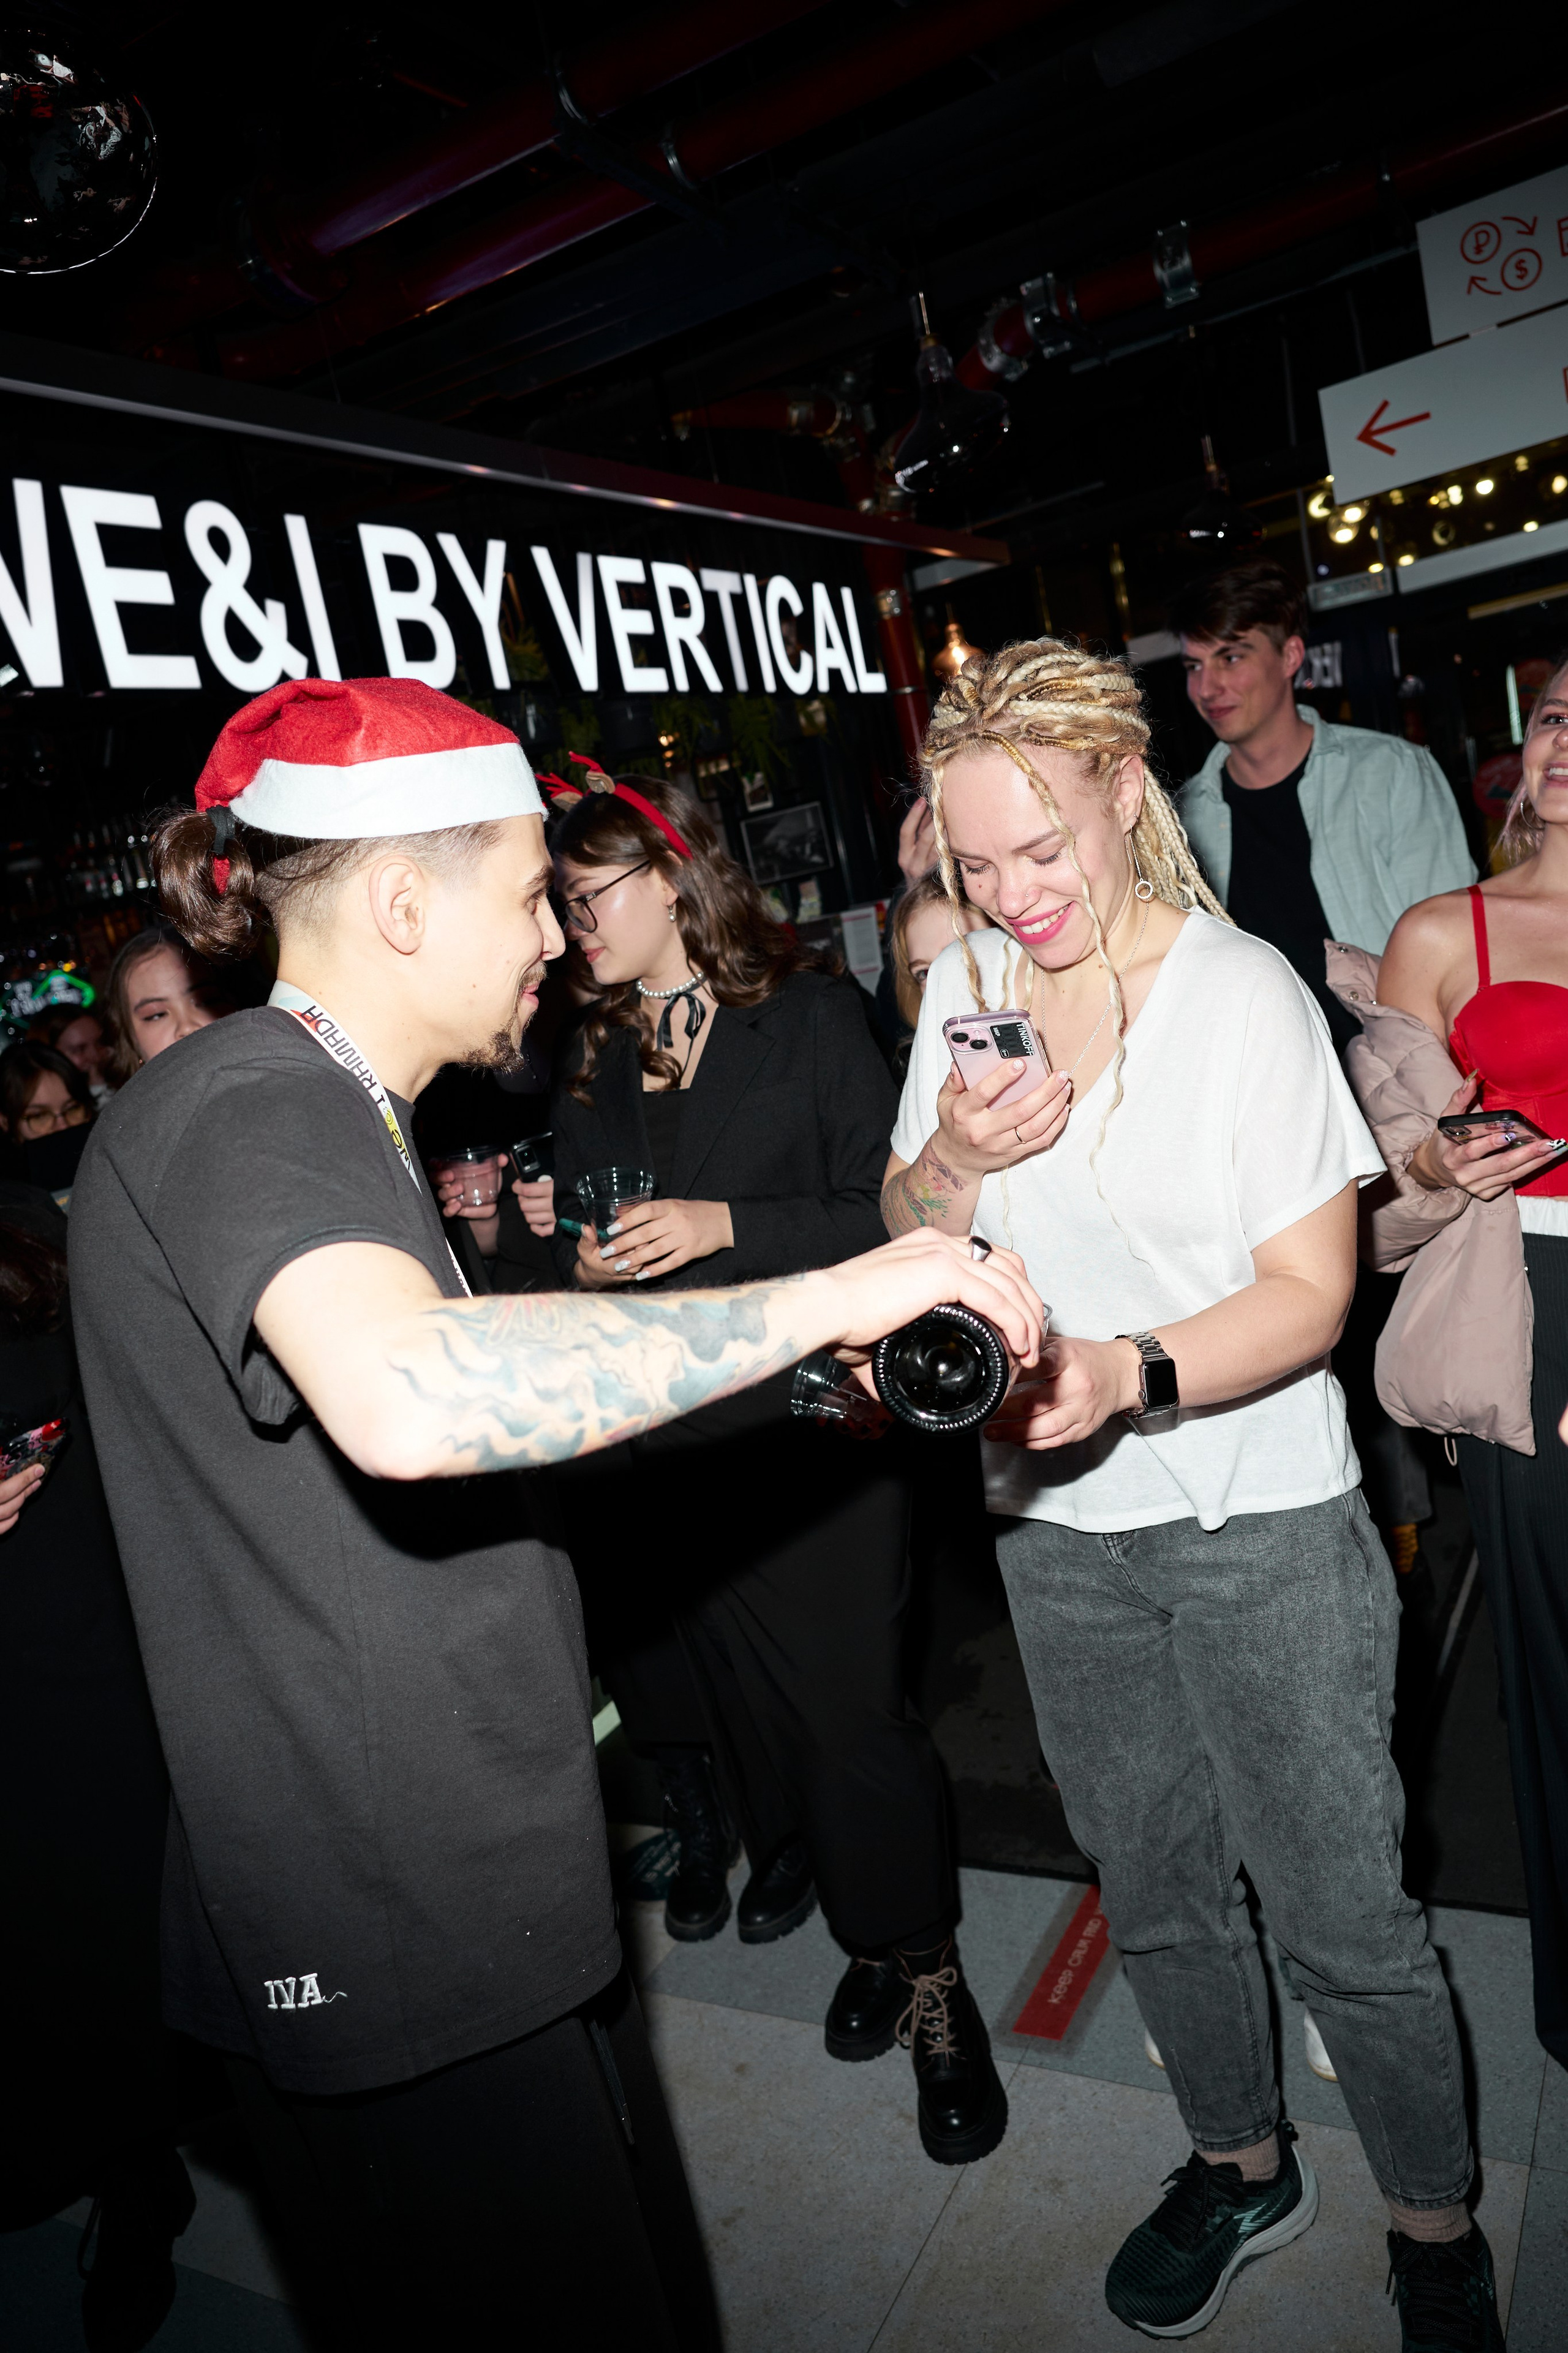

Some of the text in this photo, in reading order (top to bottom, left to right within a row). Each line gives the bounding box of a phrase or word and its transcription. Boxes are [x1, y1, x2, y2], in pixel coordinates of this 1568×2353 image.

[356, 523, 511, 691] BY
[530, 545, 888, 696] VERTICAL
[301, 1006, 377, 1089] RAMADA
[1017, 1022, 1034, 1056] TINKOFF
[264, 1973, 323, 2009] IVA
